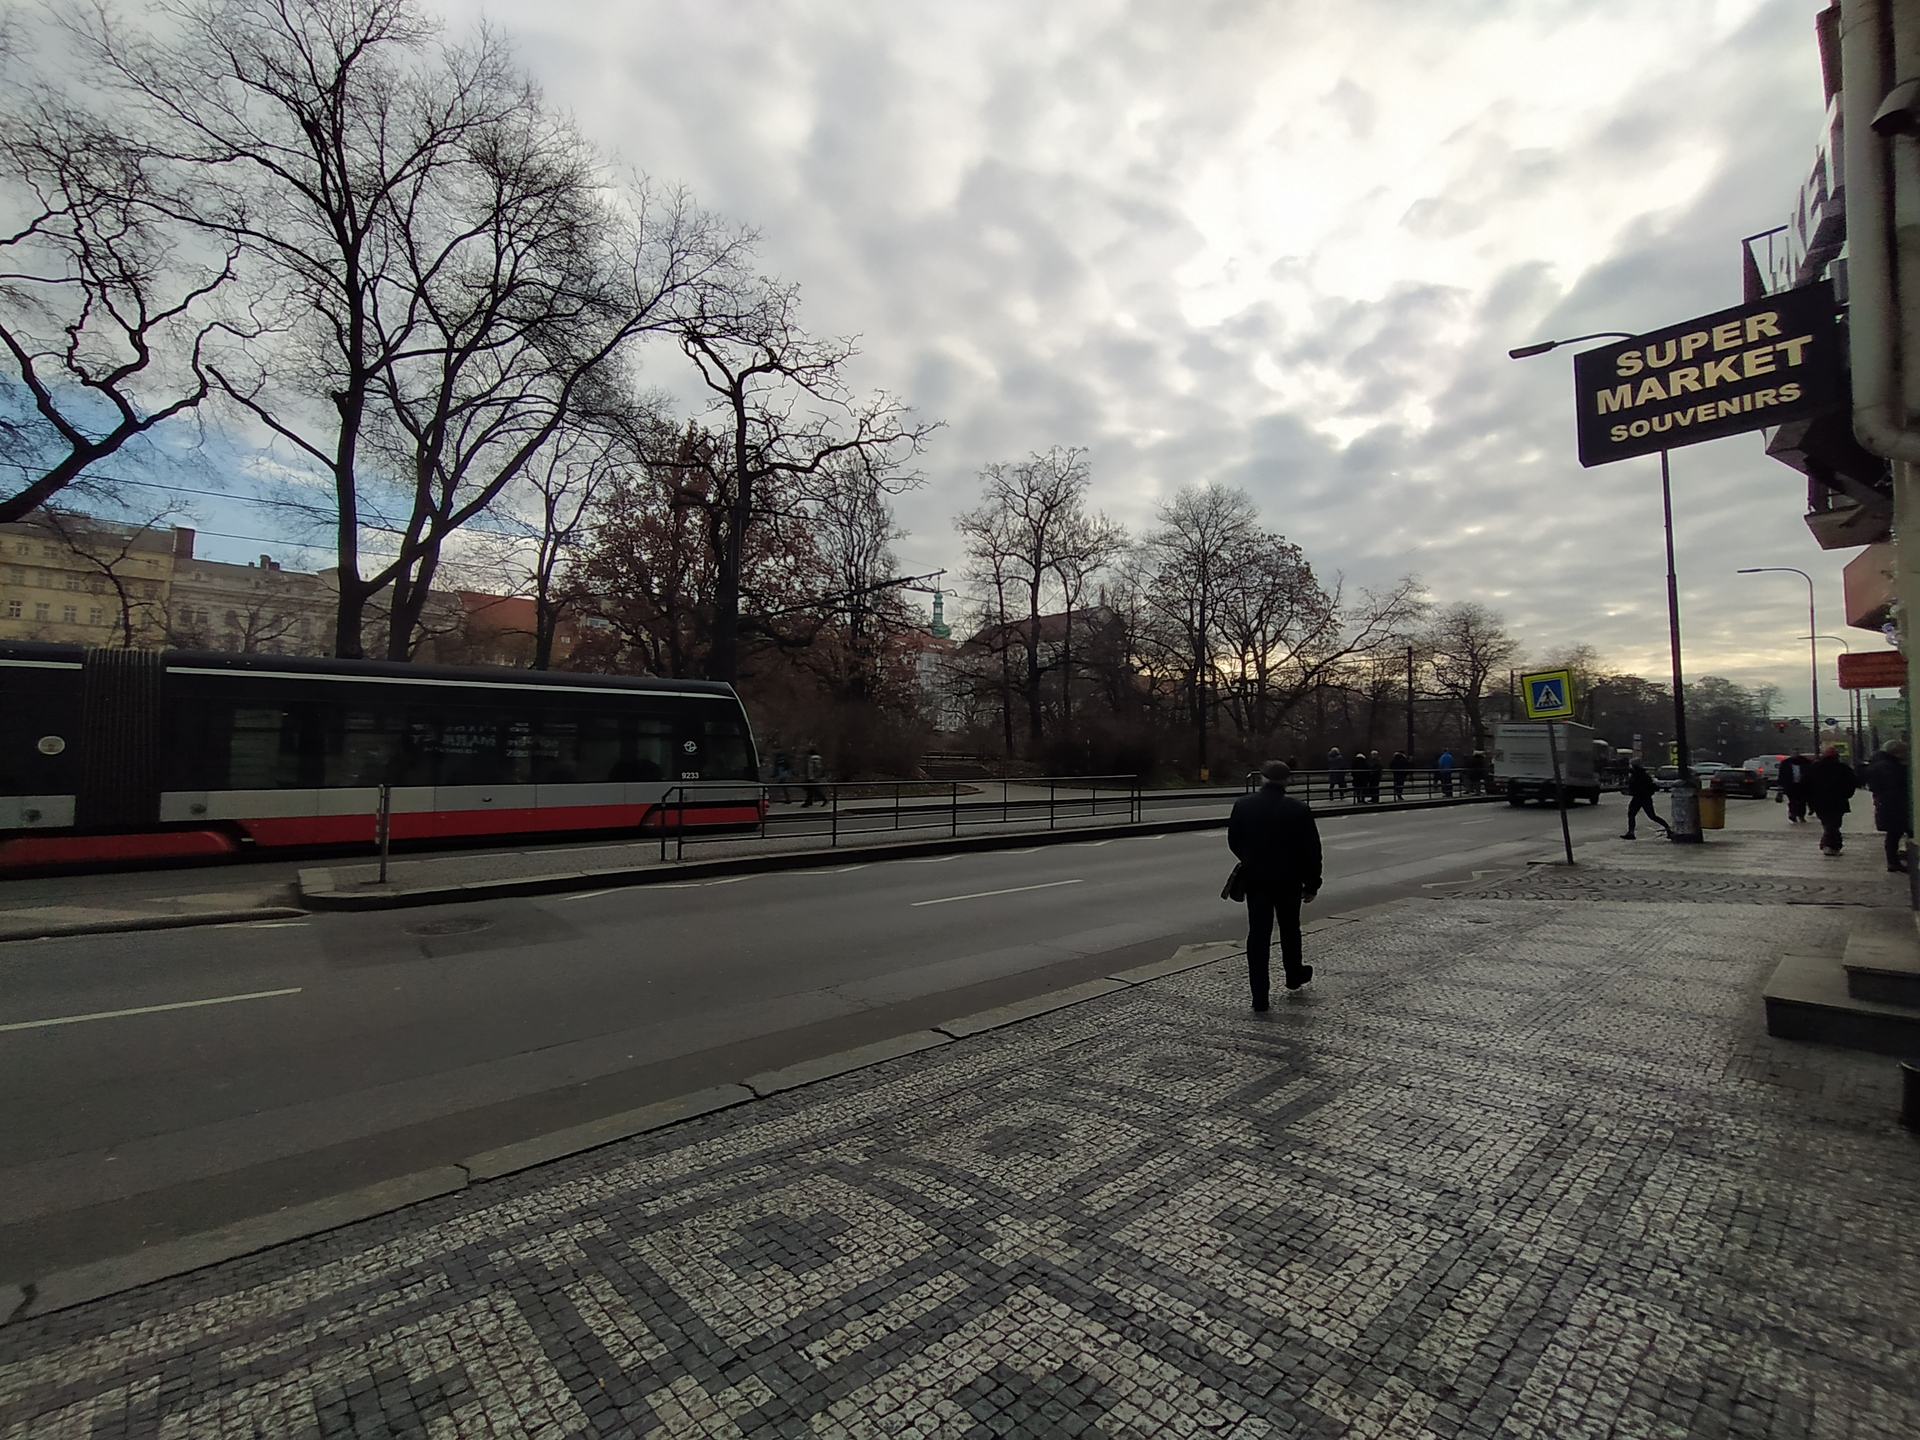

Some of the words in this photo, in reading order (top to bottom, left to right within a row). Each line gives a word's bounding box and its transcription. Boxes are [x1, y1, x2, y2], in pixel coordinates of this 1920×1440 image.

[1597, 334, 1813, 415] MARKET
[1616, 311, 1782, 377] SUPER
[1610, 382, 1801, 442] SOUVENIRS
